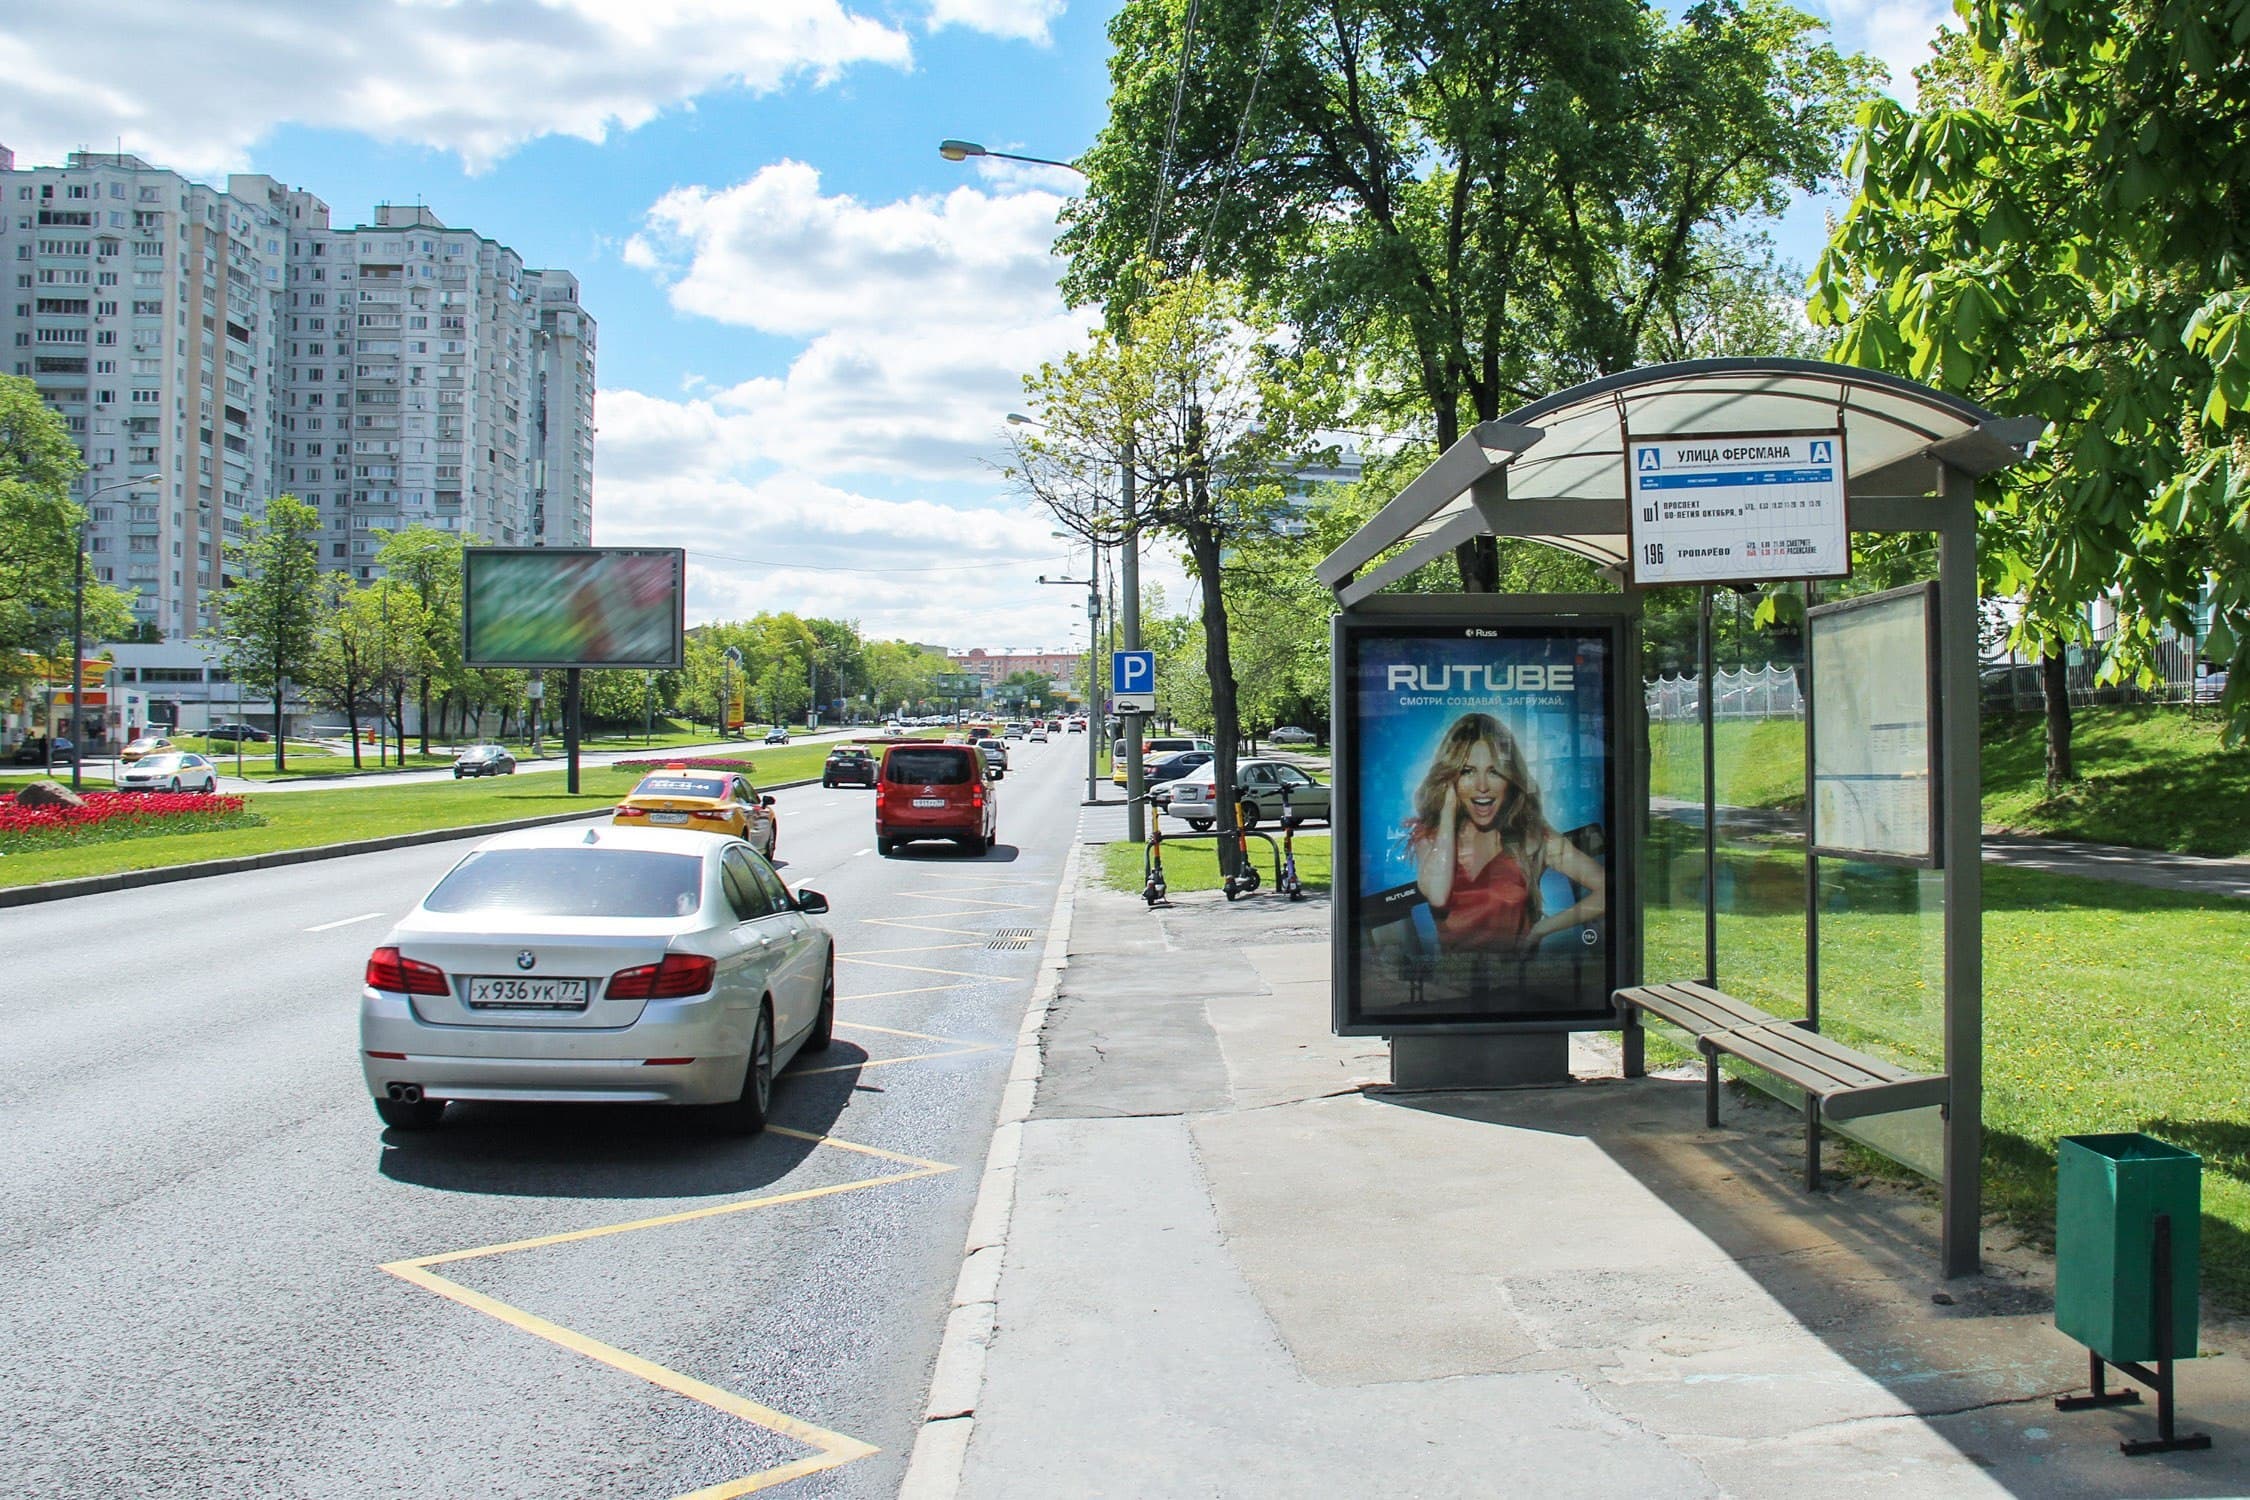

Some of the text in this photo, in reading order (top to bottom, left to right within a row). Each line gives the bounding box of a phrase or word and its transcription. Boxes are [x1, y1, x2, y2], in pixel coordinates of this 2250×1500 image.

[1677, 448, 1719, 463] УЛИЦА
[1722, 446, 1790, 460] ФЕРСМАНА
[1663, 501, 1700, 510] ПРОСПЕКТ
[1643, 543, 1664, 565] 196
[1475, 629, 1498, 637] Russ
[1124, 656, 1147, 689] P
[1388, 665, 1575, 691] RUTUBE
